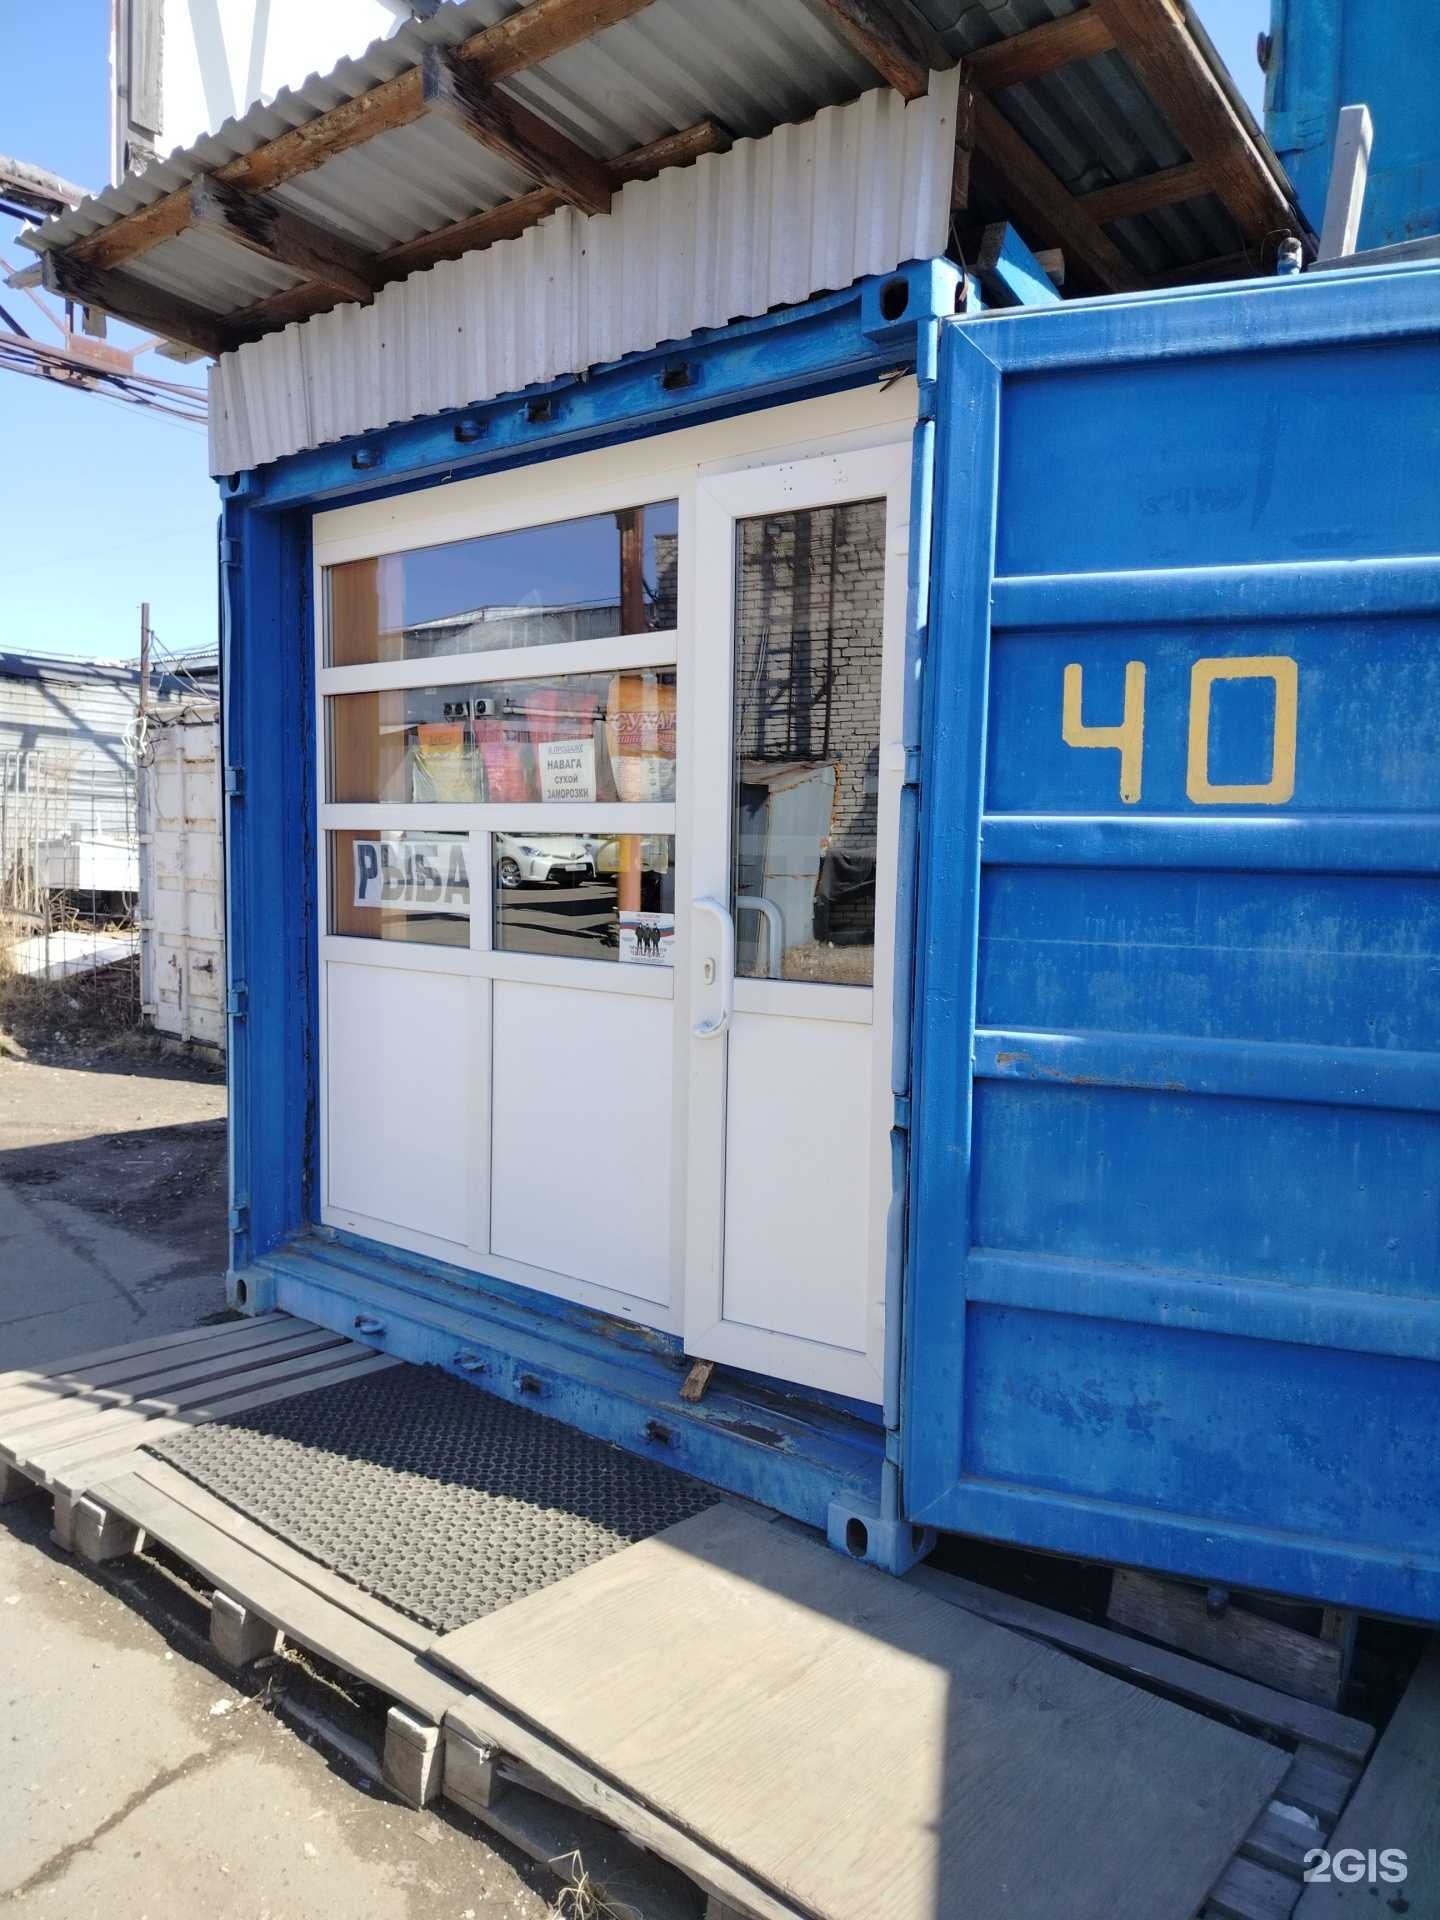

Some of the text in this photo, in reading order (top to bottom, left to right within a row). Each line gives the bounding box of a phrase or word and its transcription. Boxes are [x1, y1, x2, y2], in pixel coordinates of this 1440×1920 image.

[1062, 656, 1298, 805] 40
[547, 758, 582, 770] НАВАГА
[554, 773, 579, 785] СУХОЙ
[547, 788, 589, 799] ЗАМОРОЗКИ
[357, 844, 470, 905] РЫБА
